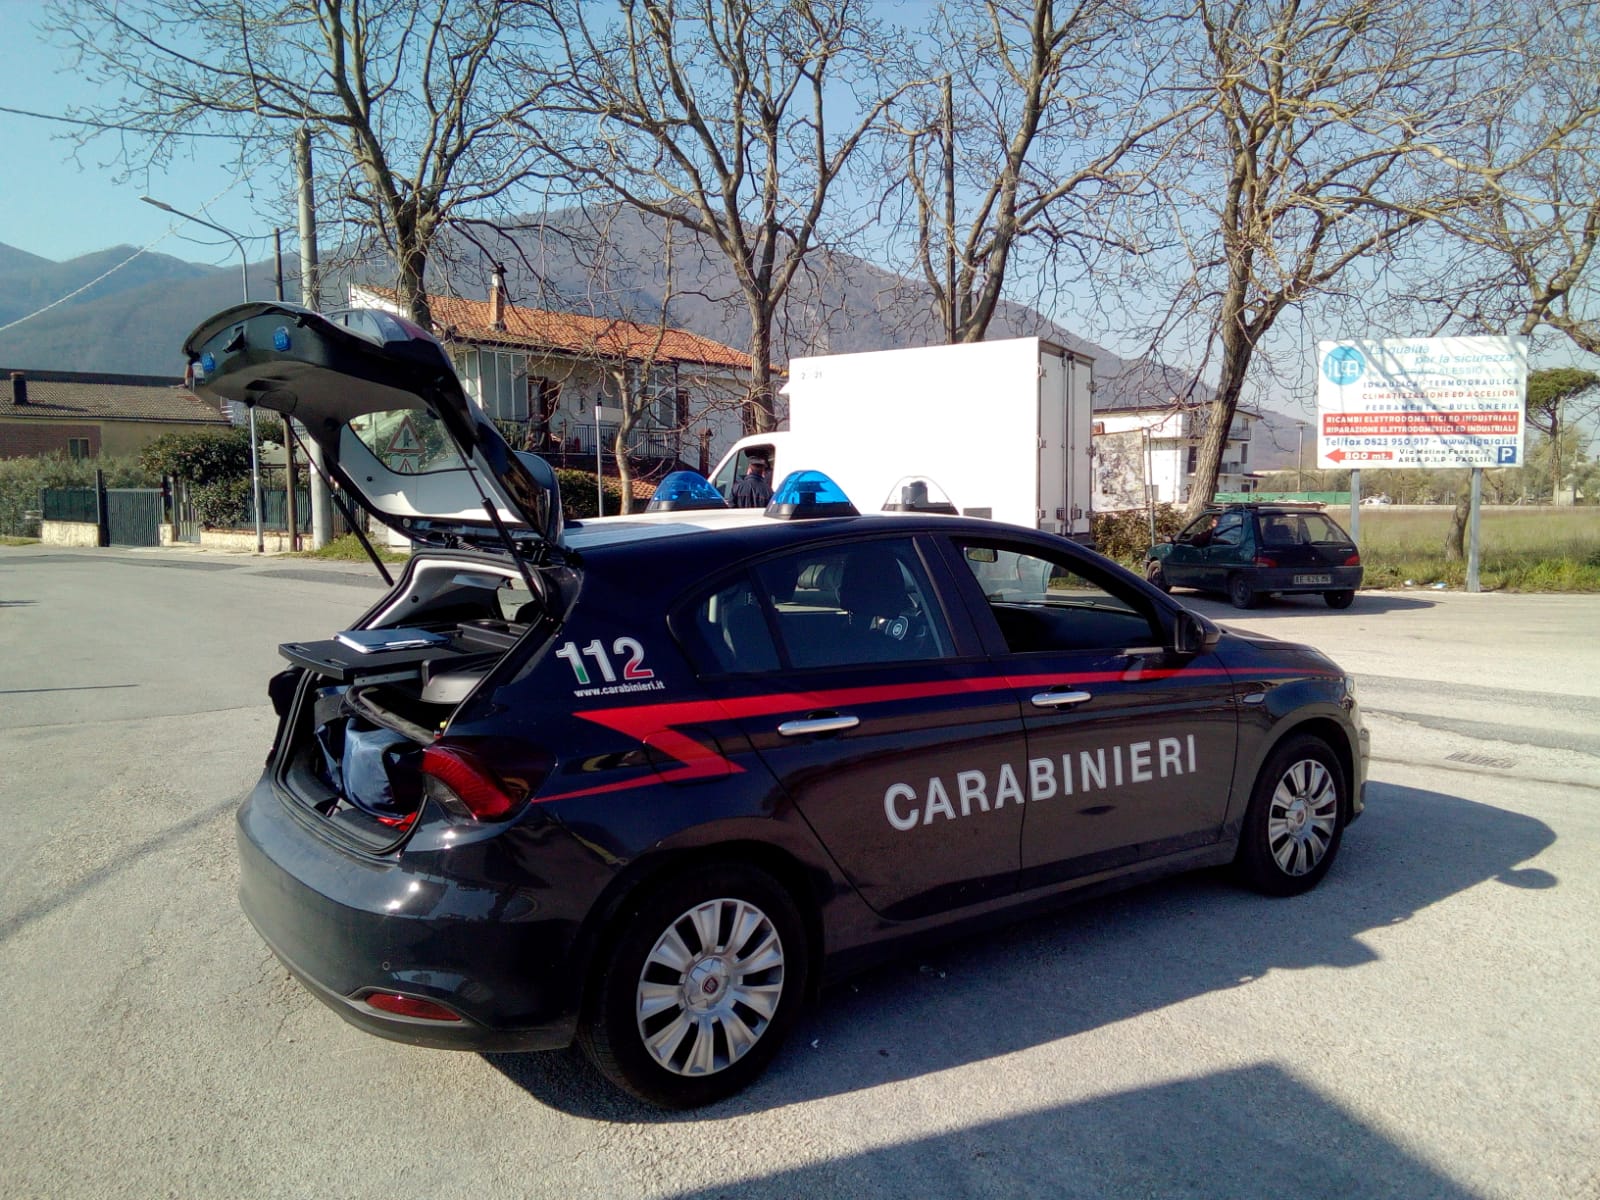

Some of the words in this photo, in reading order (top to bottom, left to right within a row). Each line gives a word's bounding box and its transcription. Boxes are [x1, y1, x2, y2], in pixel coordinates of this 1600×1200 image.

[1415, 355, 1434, 365] per
[1440, 353, 1450, 364] la
[1362, 392, 1449, 400] CLIMATIZZAZIONE
[1467, 389, 1519, 398] ACCESSORI
[1449, 402, 1519, 410] BULLONERIA
[1326, 415, 1363, 424] RICAMBI
[1364, 414, 1447, 423] ELETTRODOMESTICI
[1448, 414, 1459, 422] ED
[1462, 413, 1517, 422] INDUSTRIALI
[1326, 426, 1379, 434] RIPARAZIONE
[1380, 425, 1454, 433] ELETTRODOMESTICI
[1455, 425, 1466, 433] ED
[1467, 424, 1516, 432] INDUSTRIALI
[1325, 437, 1361, 446] Tel/fax
[1364, 437, 1389, 446] 0823
[1391, 437, 1411, 446] 950
[1413, 438, 1430, 446] 917
[1345, 451, 1369, 460] 800
[555, 636, 655, 685] 112
[574, 680, 665, 697] www.carabinieri.it
[884, 734, 1196, 831] CARABINIERI
